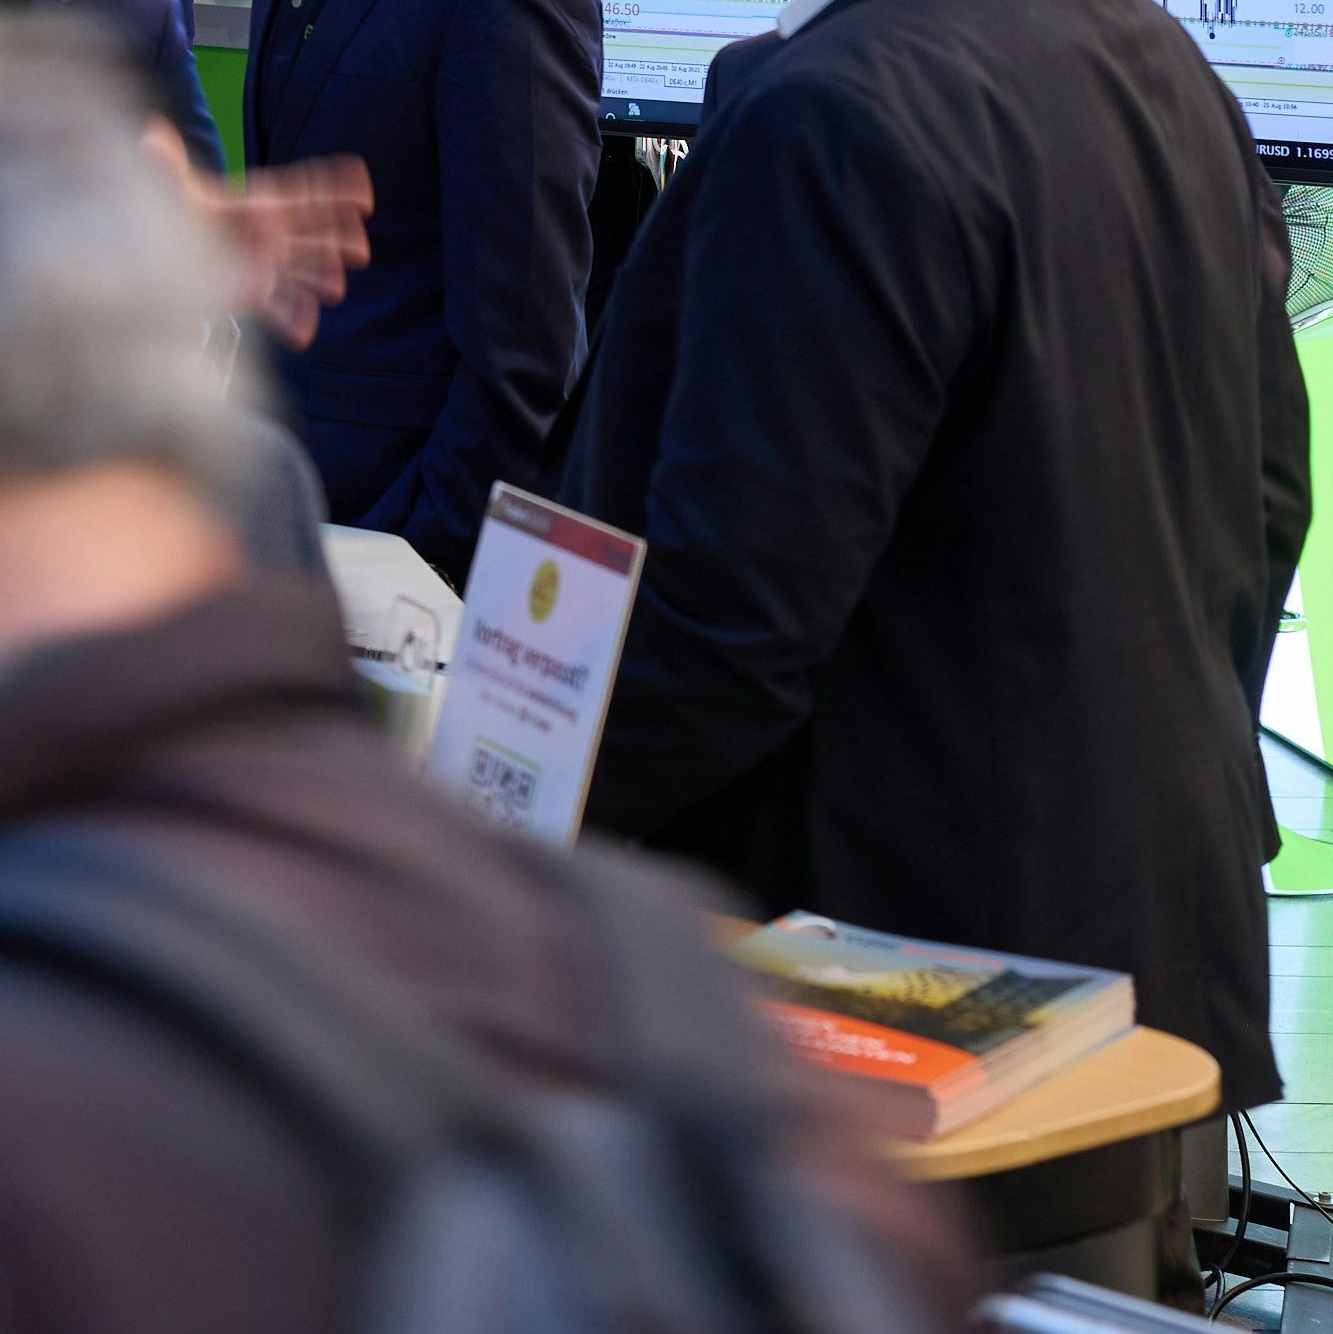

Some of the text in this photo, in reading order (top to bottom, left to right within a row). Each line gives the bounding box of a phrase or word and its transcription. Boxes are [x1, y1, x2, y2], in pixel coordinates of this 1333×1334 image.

[1294, 3, 1325, 14] 12.00
[615, 62, 623, 70] Aug
[646, 64, 655, 72] Aug
[678, 66, 687, 74] Aug
[606, 86, 628, 96] drücken
